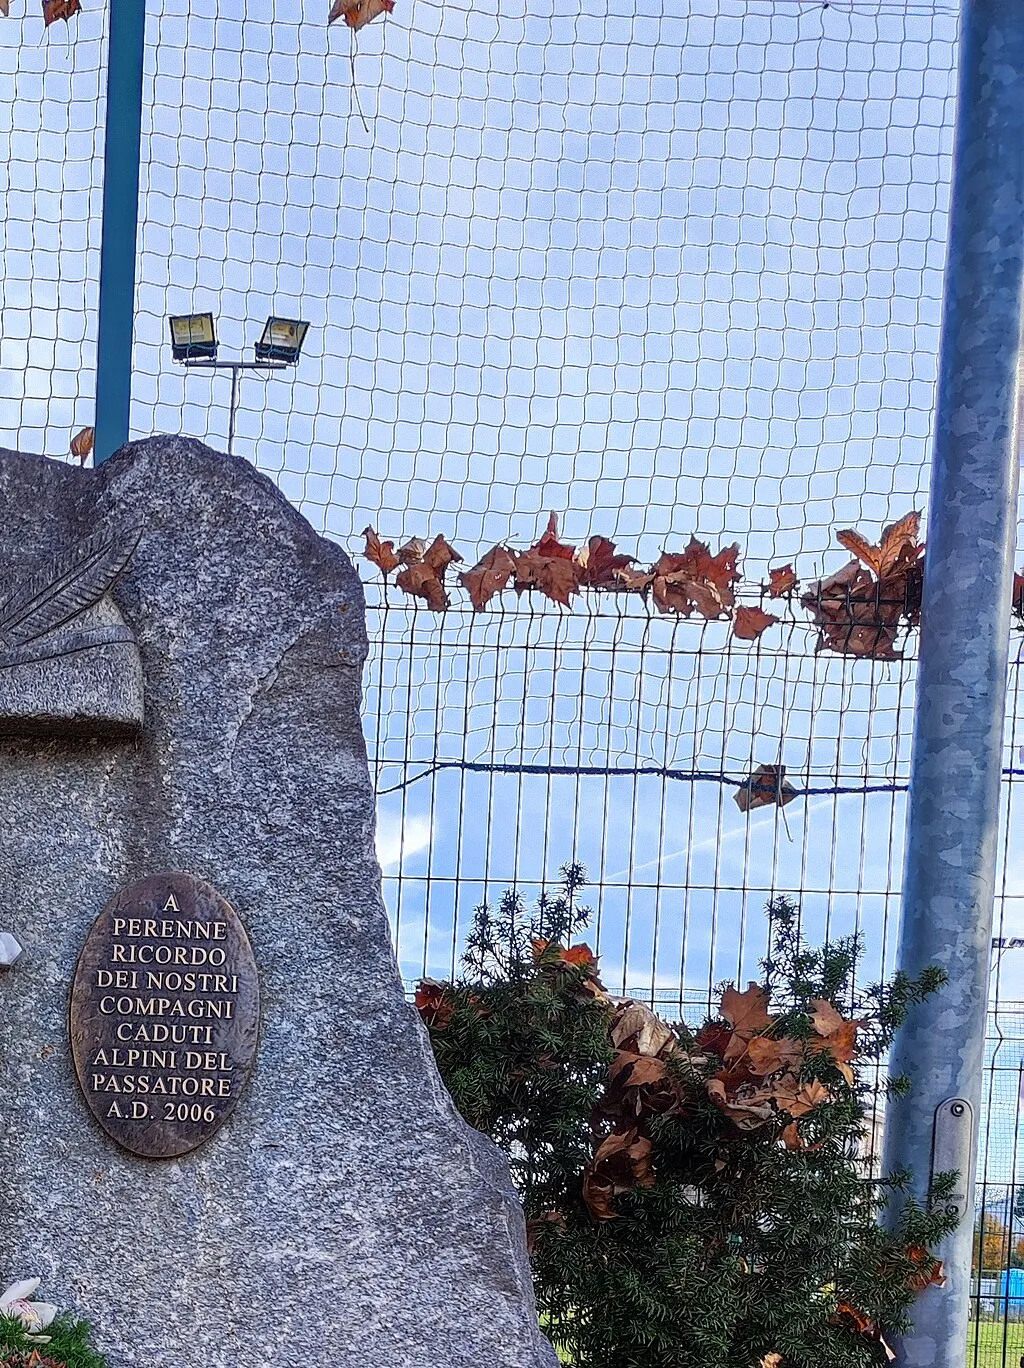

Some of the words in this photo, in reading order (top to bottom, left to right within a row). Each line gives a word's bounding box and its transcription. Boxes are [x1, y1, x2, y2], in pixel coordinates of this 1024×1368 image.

[163, 894, 179, 911] A
[113, 919, 227, 939] PERENNE
[111, 945, 225, 966] RICORDO
[97, 970, 137, 989] DEI
[147, 972, 239, 992] NOSTRI
[100, 996, 232, 1018] COMPAGNI
[117, 1023, 212, 1043] CADUTI
[93, 1049, 176, 1068] ALPINI
[185, 1052, 233, 1071] DEL
[92, 1075, 231, 1097] PASSATORE
[107, 1101, 154, 1119] A.D.
[164, 1103, 214, 1122] 2006
